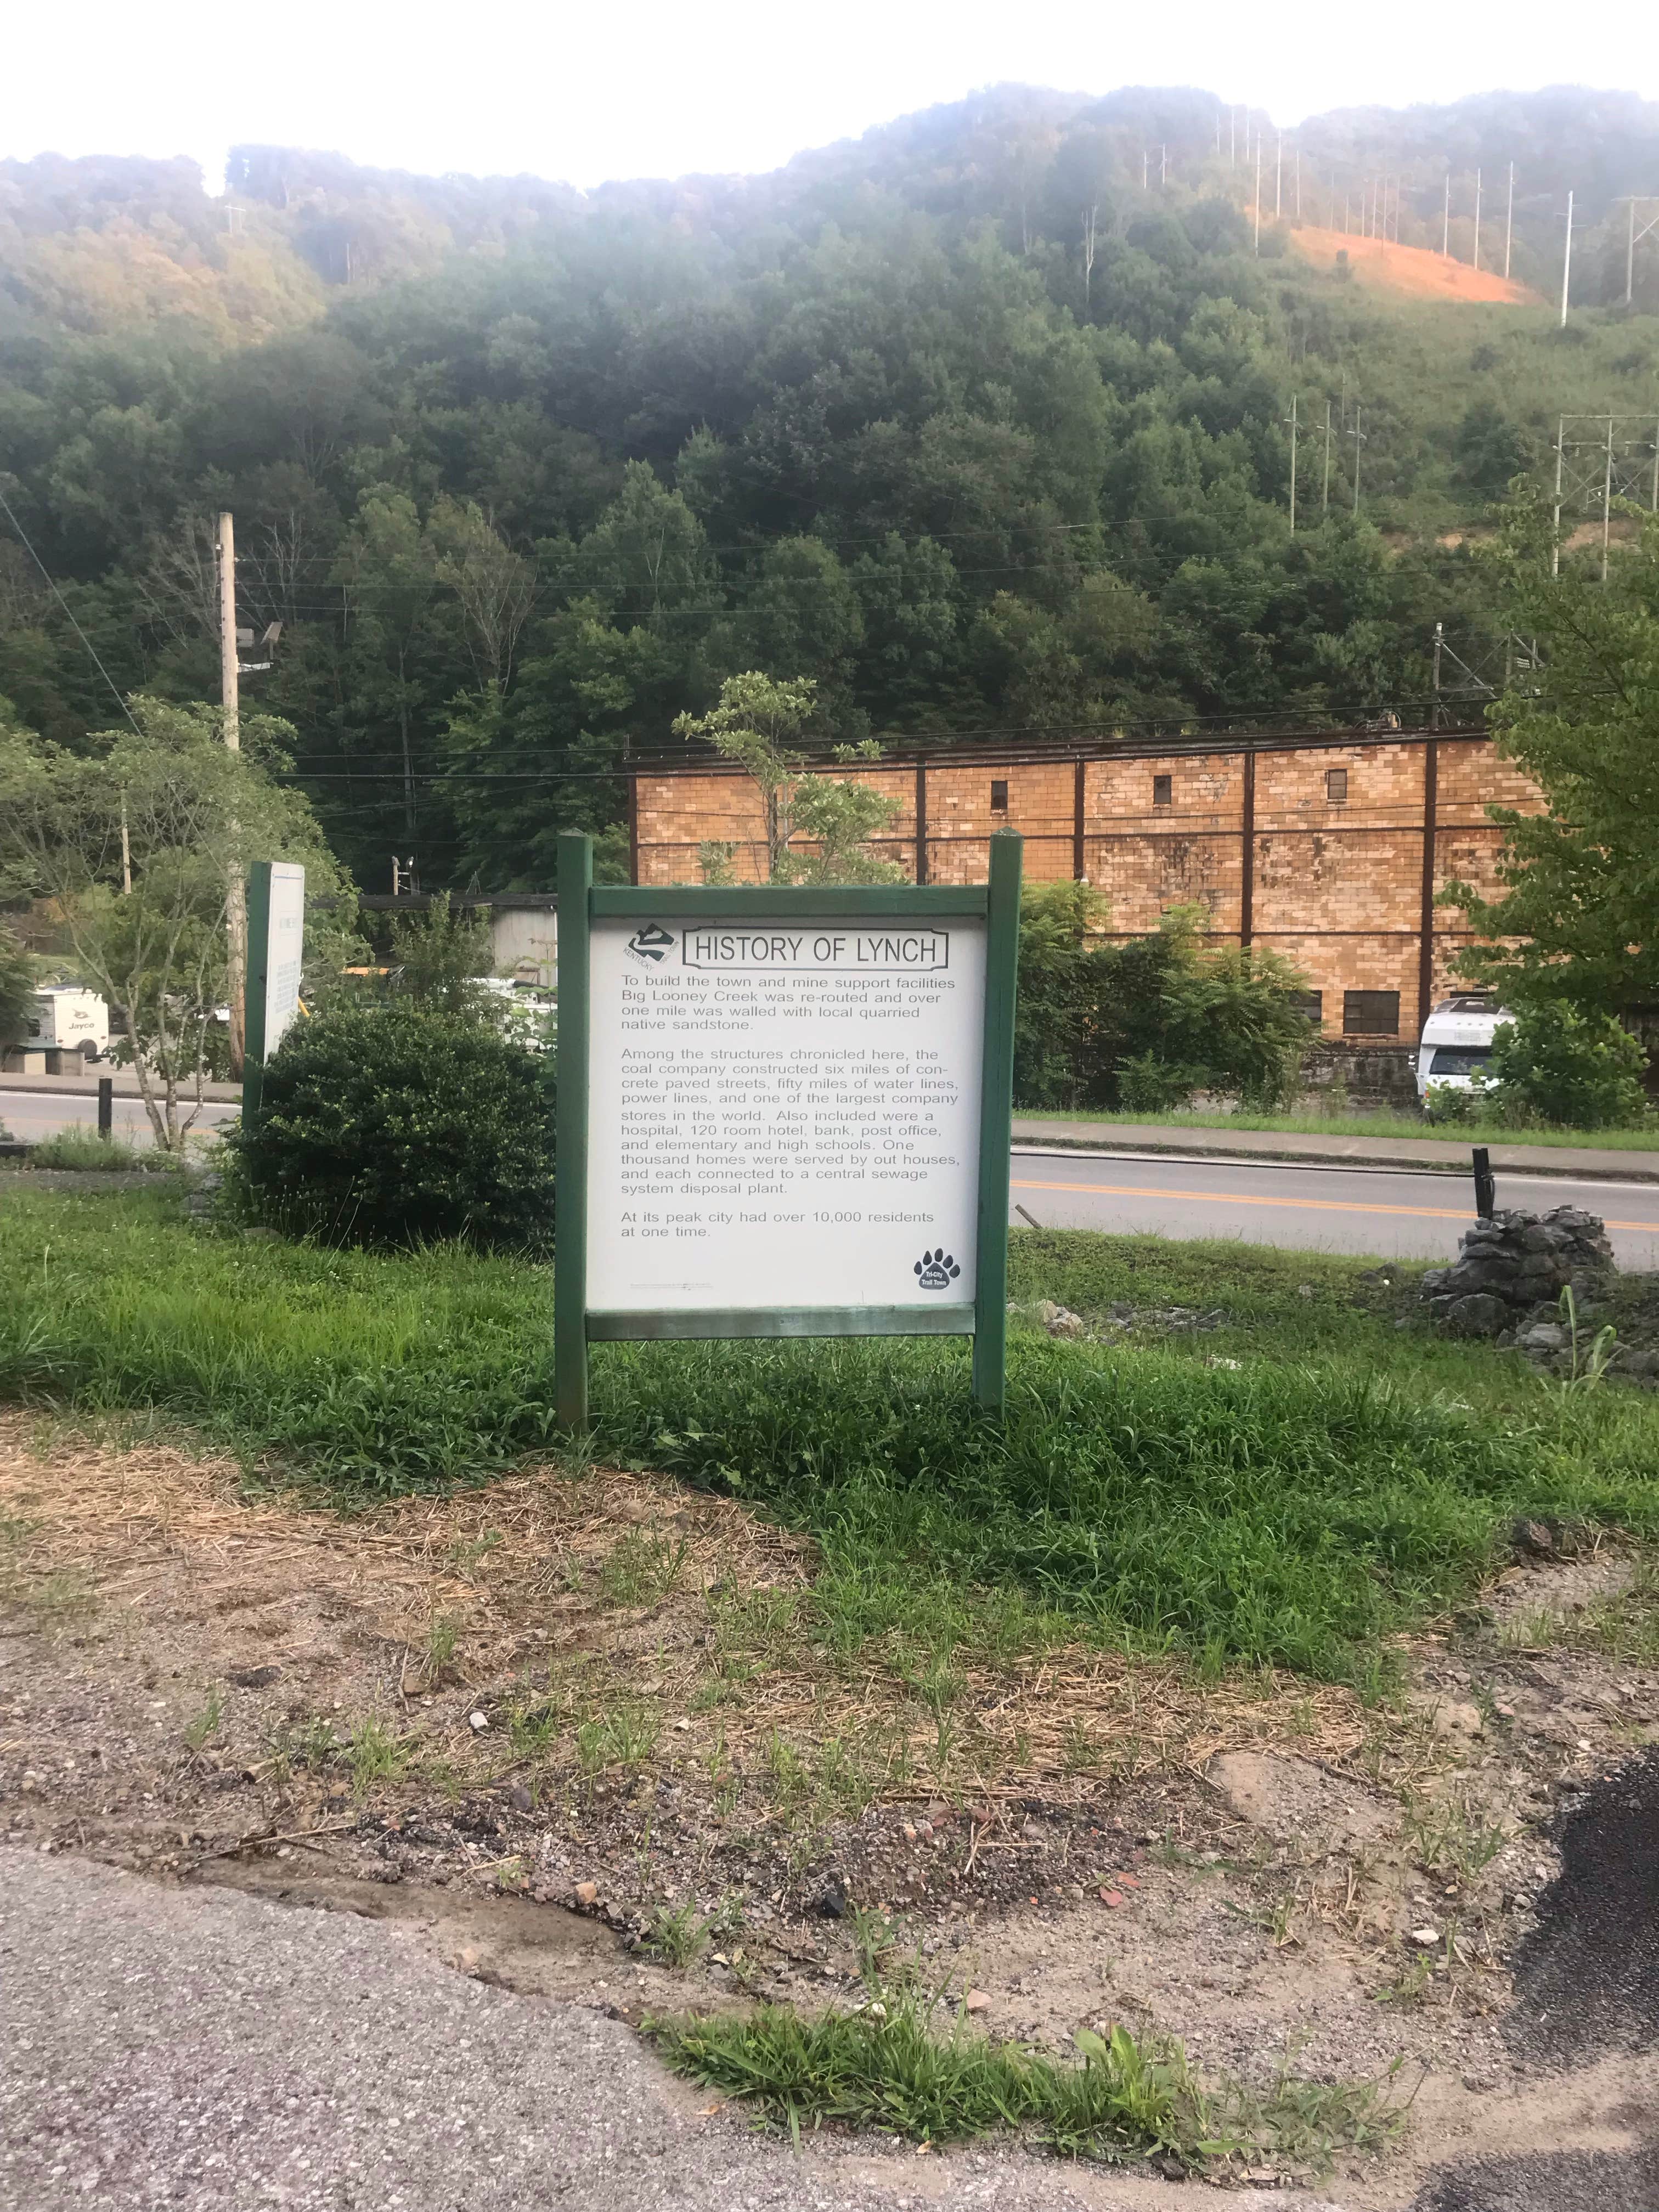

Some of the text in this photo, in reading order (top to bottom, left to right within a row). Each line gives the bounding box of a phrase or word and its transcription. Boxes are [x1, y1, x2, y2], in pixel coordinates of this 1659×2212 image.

[696, 936, 935, 962] HISTORY OF LYNCH
[623, 947, 654, 972] KENTUCKY
[621, 975, 955, 991] To build the town and mine support facilities
[622, 990, 941, 1004] Big Looney Creek was re-routed and over
[622, 1005, 919, 1020] one mile was walled with local quarried
[622, 1018, 753, 1030] native sandstone.
[621, 1048, 938, 1062] Among the structures chronicled here, the
[622, 1063, 948, 1076] coal company constructed six miles of con-
[622, 1077, 958, 1091] crete paved streets, fifty miles of water lines,
[622, 1093, 958, 1106] power lines, and one of the largest company
[621, 1110, 666, 1121] stores
[674, 1110, 685, 1120] in
[692, 1110, 715, 1121] the
[721, 1110, 765, 1121] world.
[776, 1110, 808, 1122] Also
[815, 1110, 876, 1121] included
[883, 1113, 918, 1121] were
[622, 1124, 941, 1138] hospital, 120 room hotel, bank, post office,
[621, 1138, 914, 1153] and elementary and high schools. One
[621, 1154, 960, 1166] thousand homes were served by out houses,
[621, 1168, 928, 1181] and each connected to a central sewage
[622, 1182, 787, 1196] system disposal plant.
[621, 1212, 636, 1222] At
[644, 1212, 659, 1222] its
[667, 1212, 702, 1224] peak
[708, 1212, 733, 1224] city
[740, 1212, 766, 1222] had
[813, 1211, 861, 1223] 10,000
[868, 1212, 934, 1222] residents
[622, 1227, 635, 1237] at
[676, 1226, 710, 1237] time.
